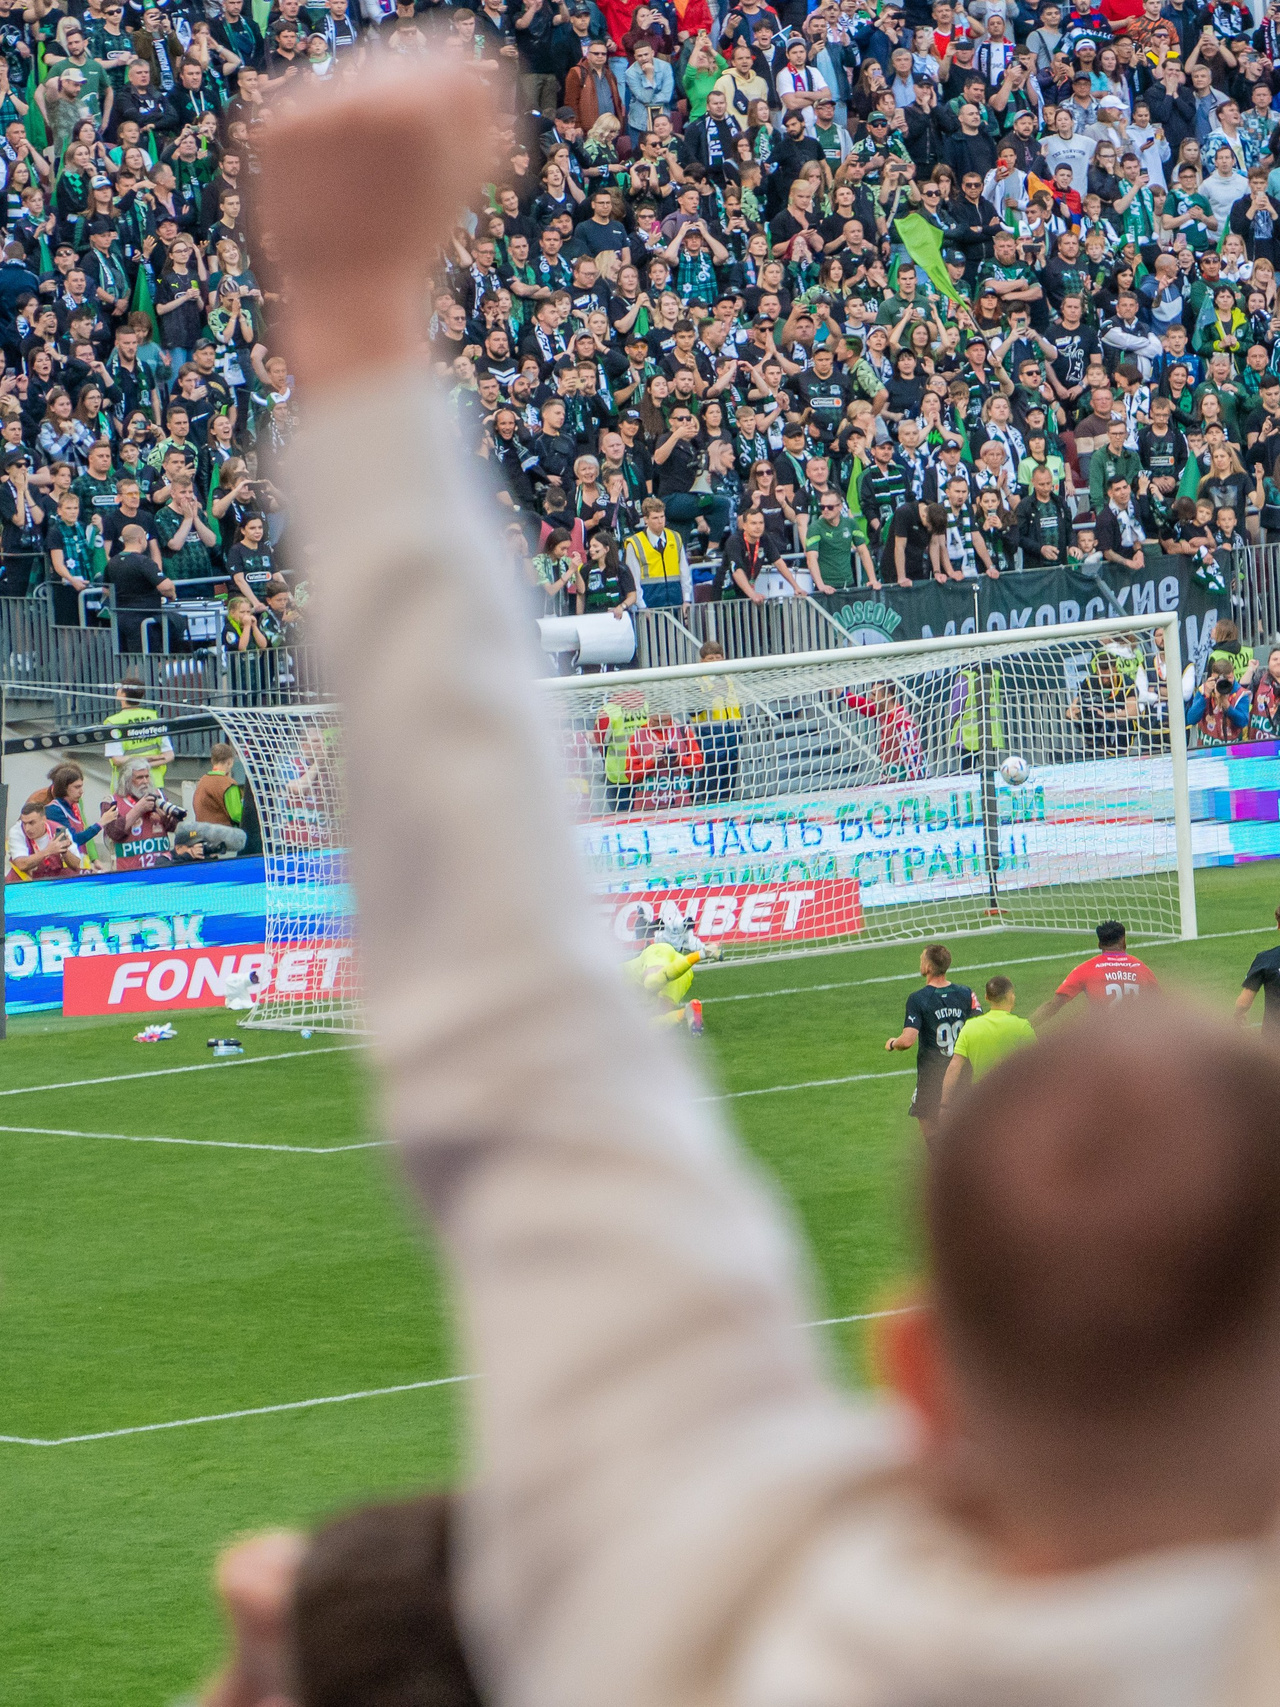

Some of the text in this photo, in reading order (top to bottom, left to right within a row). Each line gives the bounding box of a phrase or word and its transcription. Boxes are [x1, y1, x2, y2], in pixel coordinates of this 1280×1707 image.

[122, 836, 170, 858] PHOTO
[690, 804, 823, 859] ЧАСТЬ
[107, 950, 352, 1005] FONBET
[1105, 970, 1137, 982] МОЙЗЕС
